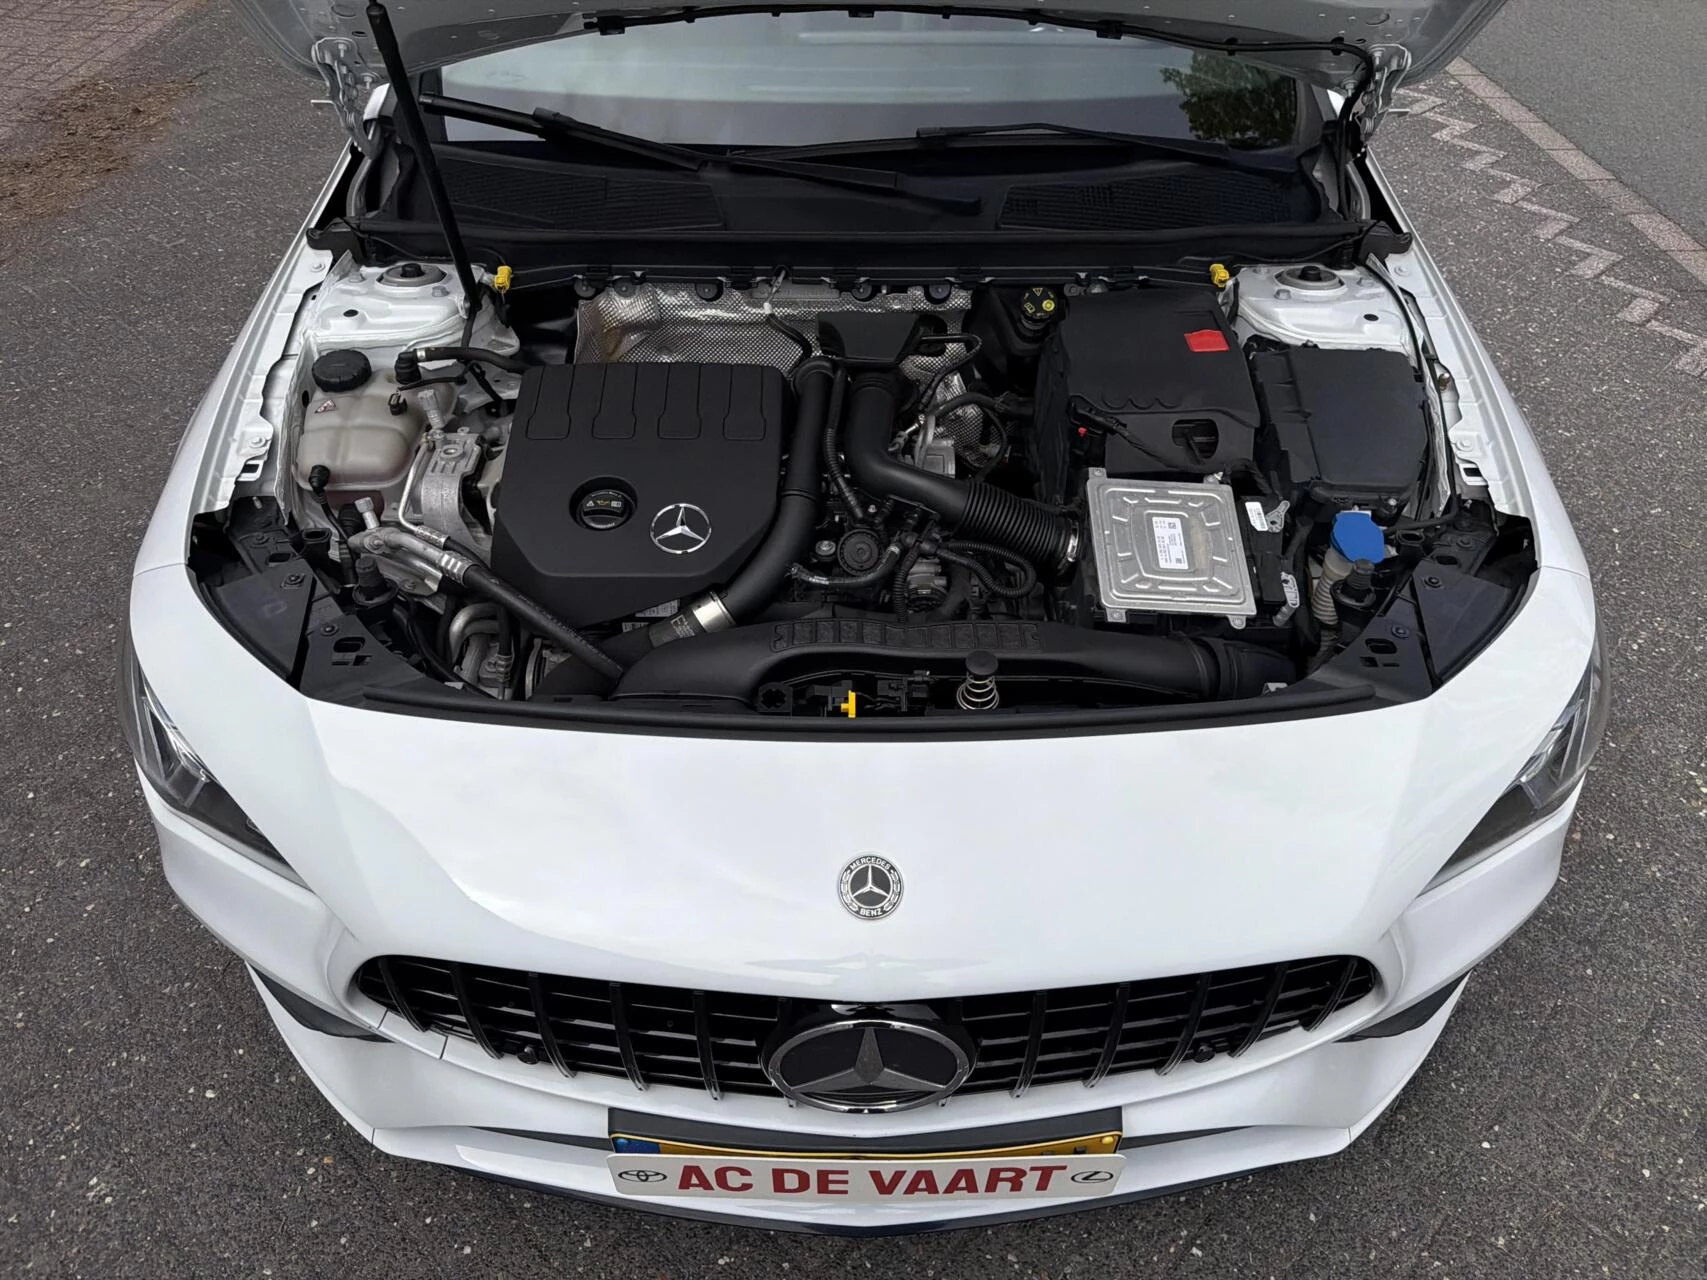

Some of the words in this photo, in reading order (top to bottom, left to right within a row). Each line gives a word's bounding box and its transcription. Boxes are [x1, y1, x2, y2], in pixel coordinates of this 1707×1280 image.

[850, 857, 891, 869] MERCEDES
[860, 908, 882, 916] BENZ
[678, 1165, 753, 1192] AC
[772, 1167, 849, 1195] DE
[868, 1165, 1067, 1195] VAART
